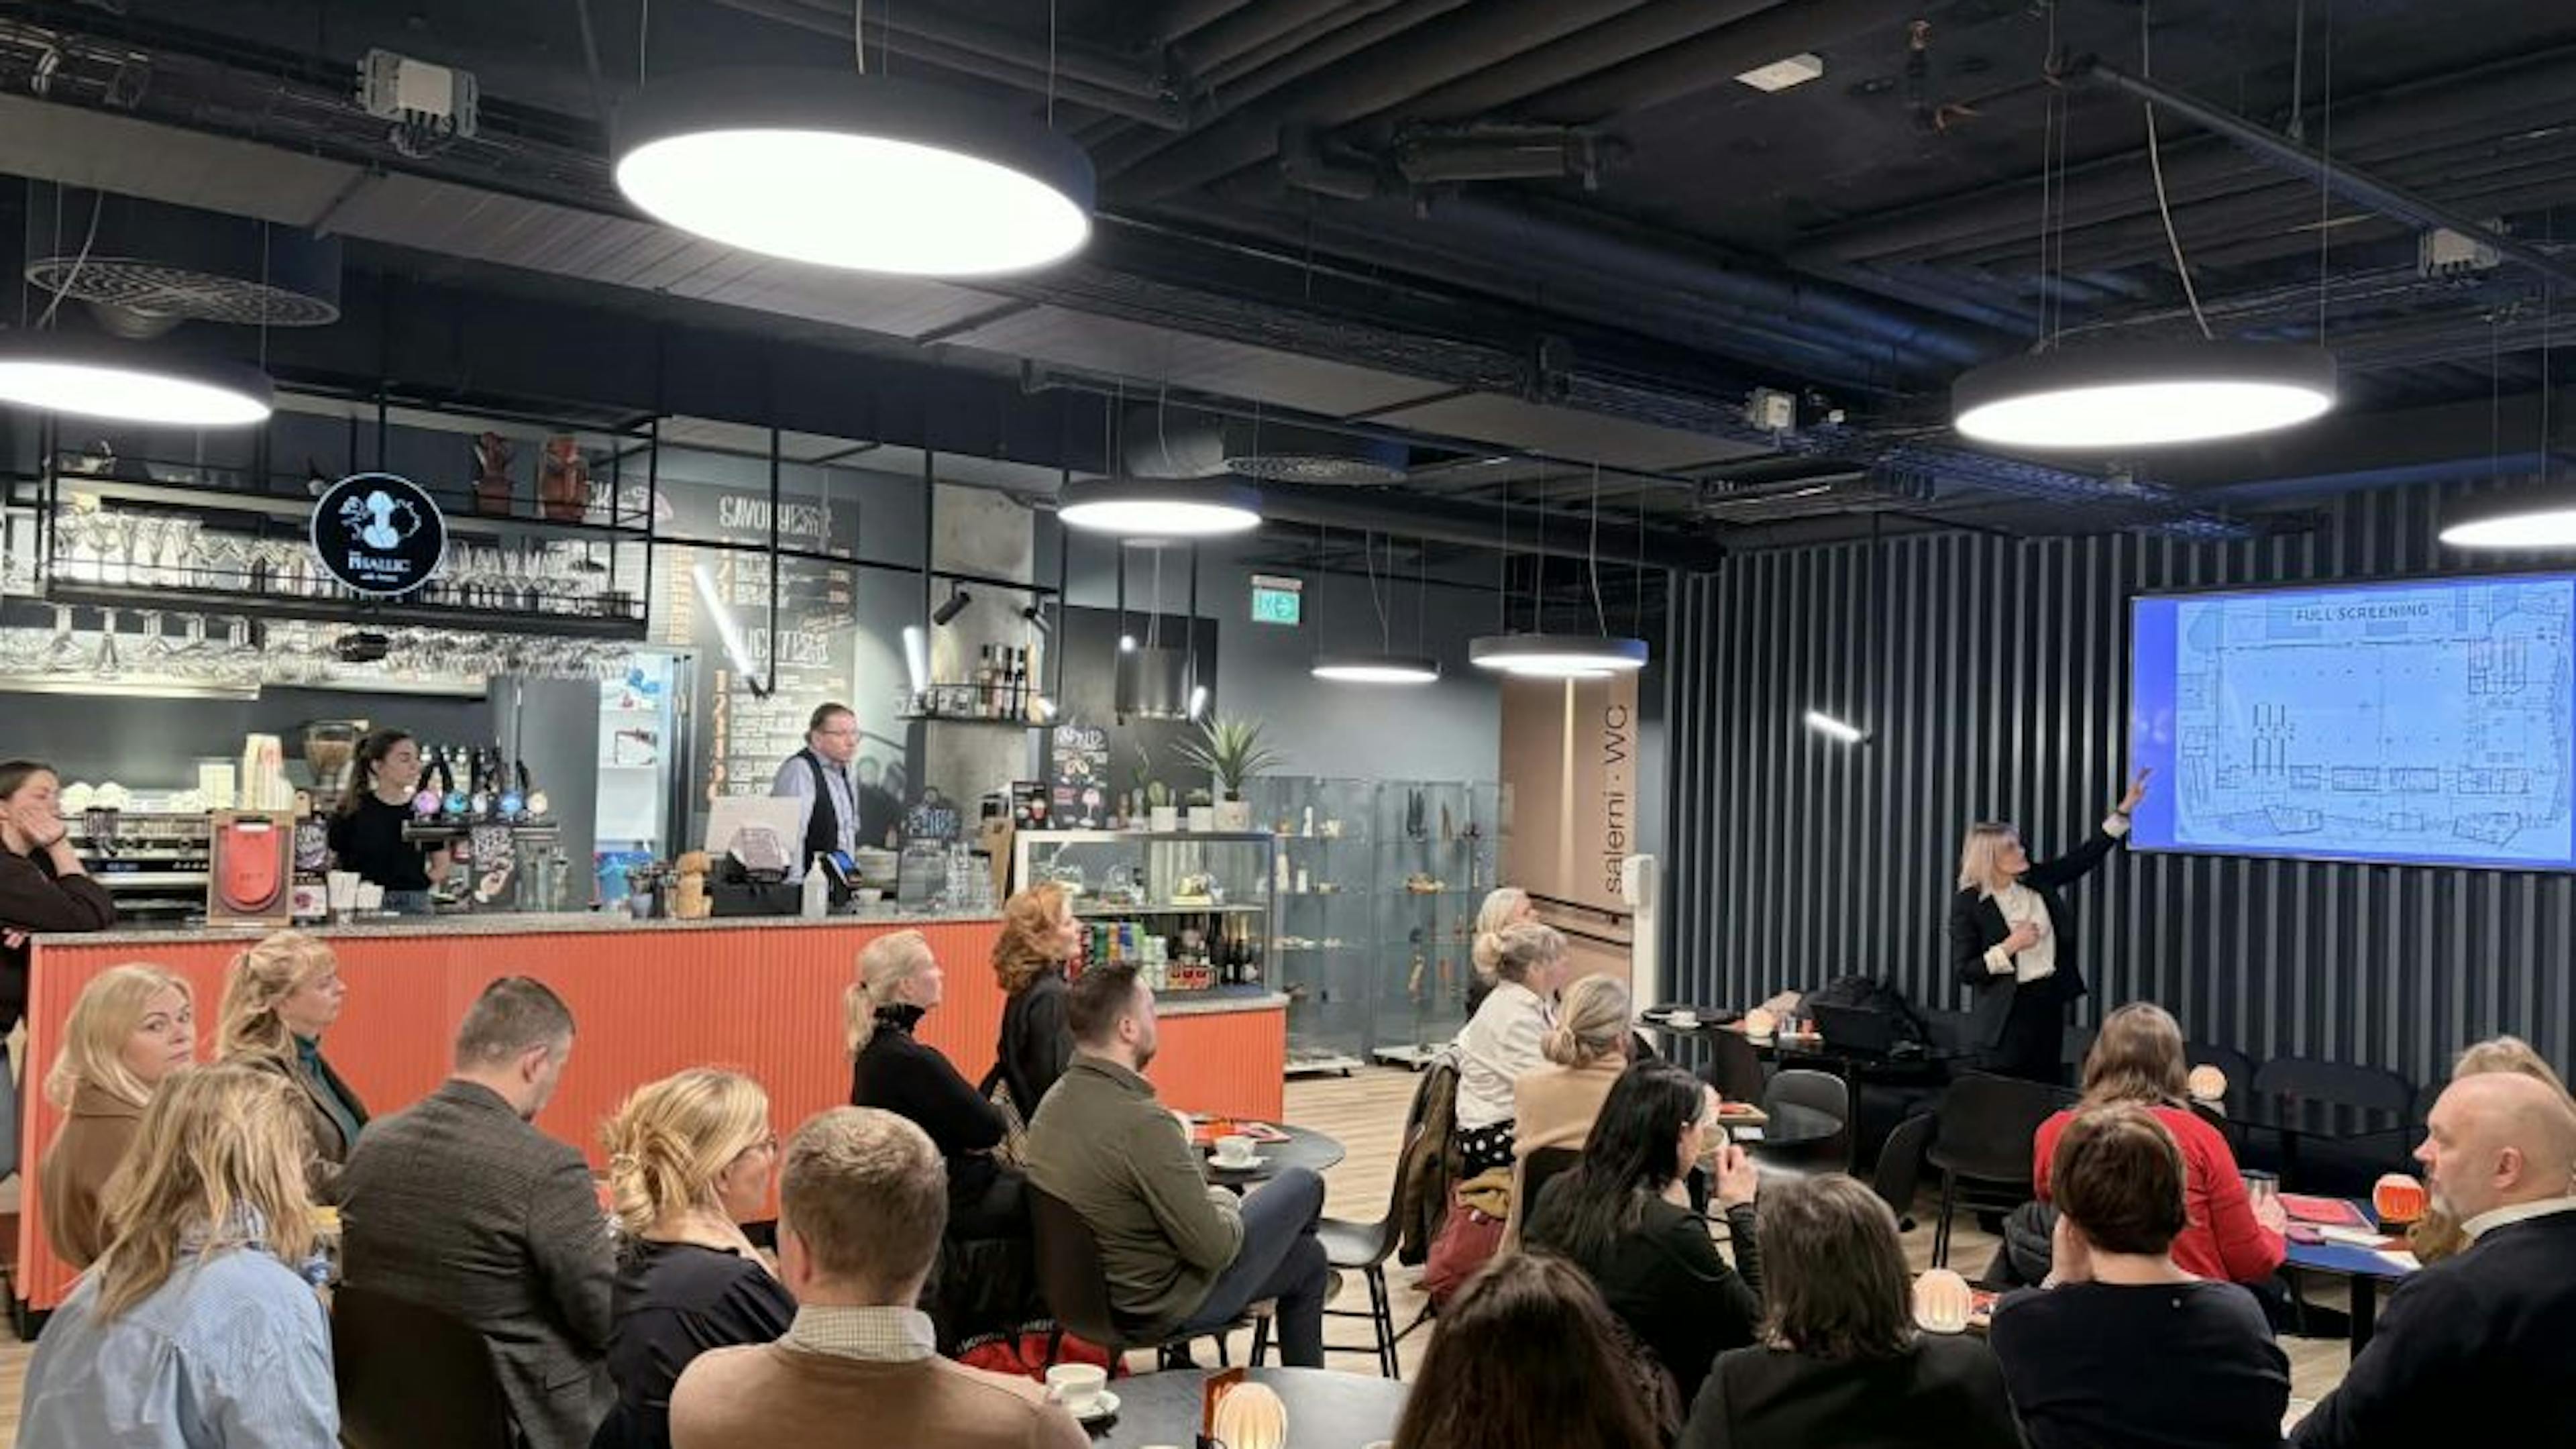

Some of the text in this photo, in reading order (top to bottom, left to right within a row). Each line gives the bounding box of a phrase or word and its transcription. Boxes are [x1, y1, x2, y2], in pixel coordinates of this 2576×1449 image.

[2296, 604, 2430, 622] FULL SCREENING
[1605, 705, 1628, 764] WC
[1603, 792, 1625, 894] salerni
